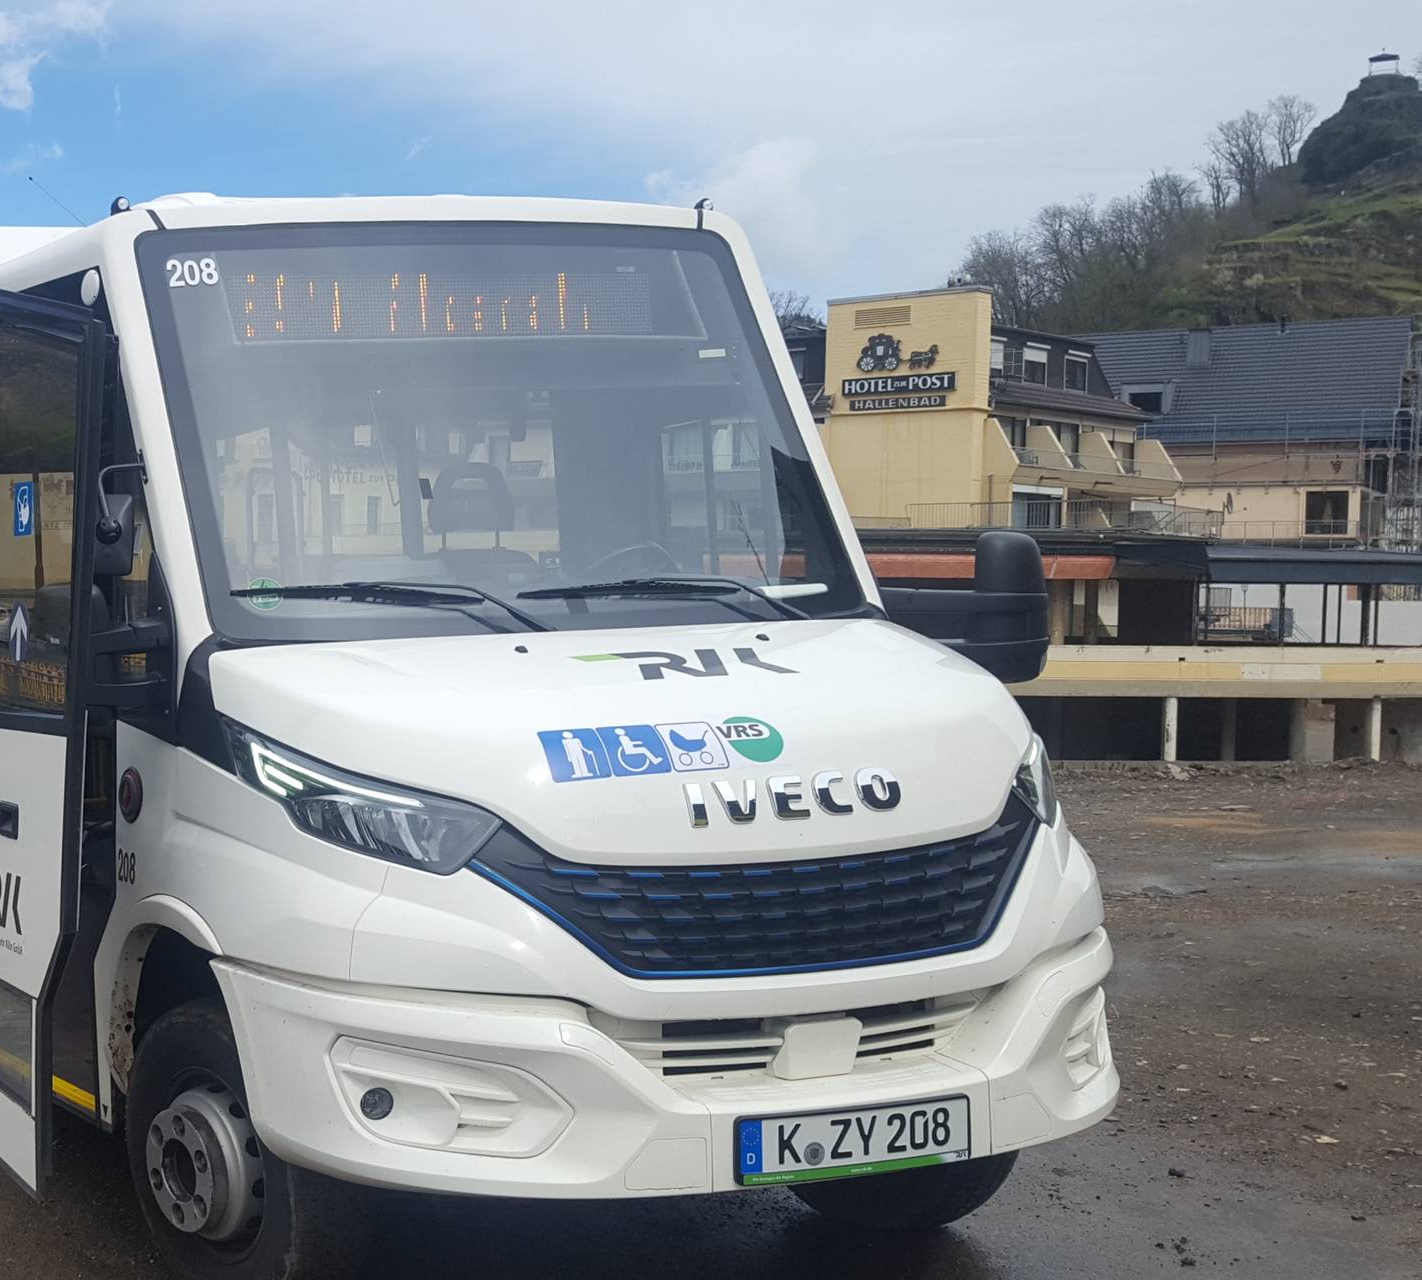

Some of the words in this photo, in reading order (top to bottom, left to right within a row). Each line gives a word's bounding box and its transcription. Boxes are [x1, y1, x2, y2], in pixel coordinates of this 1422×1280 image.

[166, 258, 218, 287] 208
[844, 379, 895, 394] HOTEL
[908, 374, 952, 390] POST
[854, 396, 940, 410] HALLENBAD
[716, 724, 763, 739] VRS
[682, 767, 901, 828] IVECO
[118, 848, 136, 885] 208
[778, 1123, 802, 1165] K
[830, 1115, 877, 1160] ZY
[887, 1107, 951, 1154] 208
[747, 1153, 756, 1165] D
